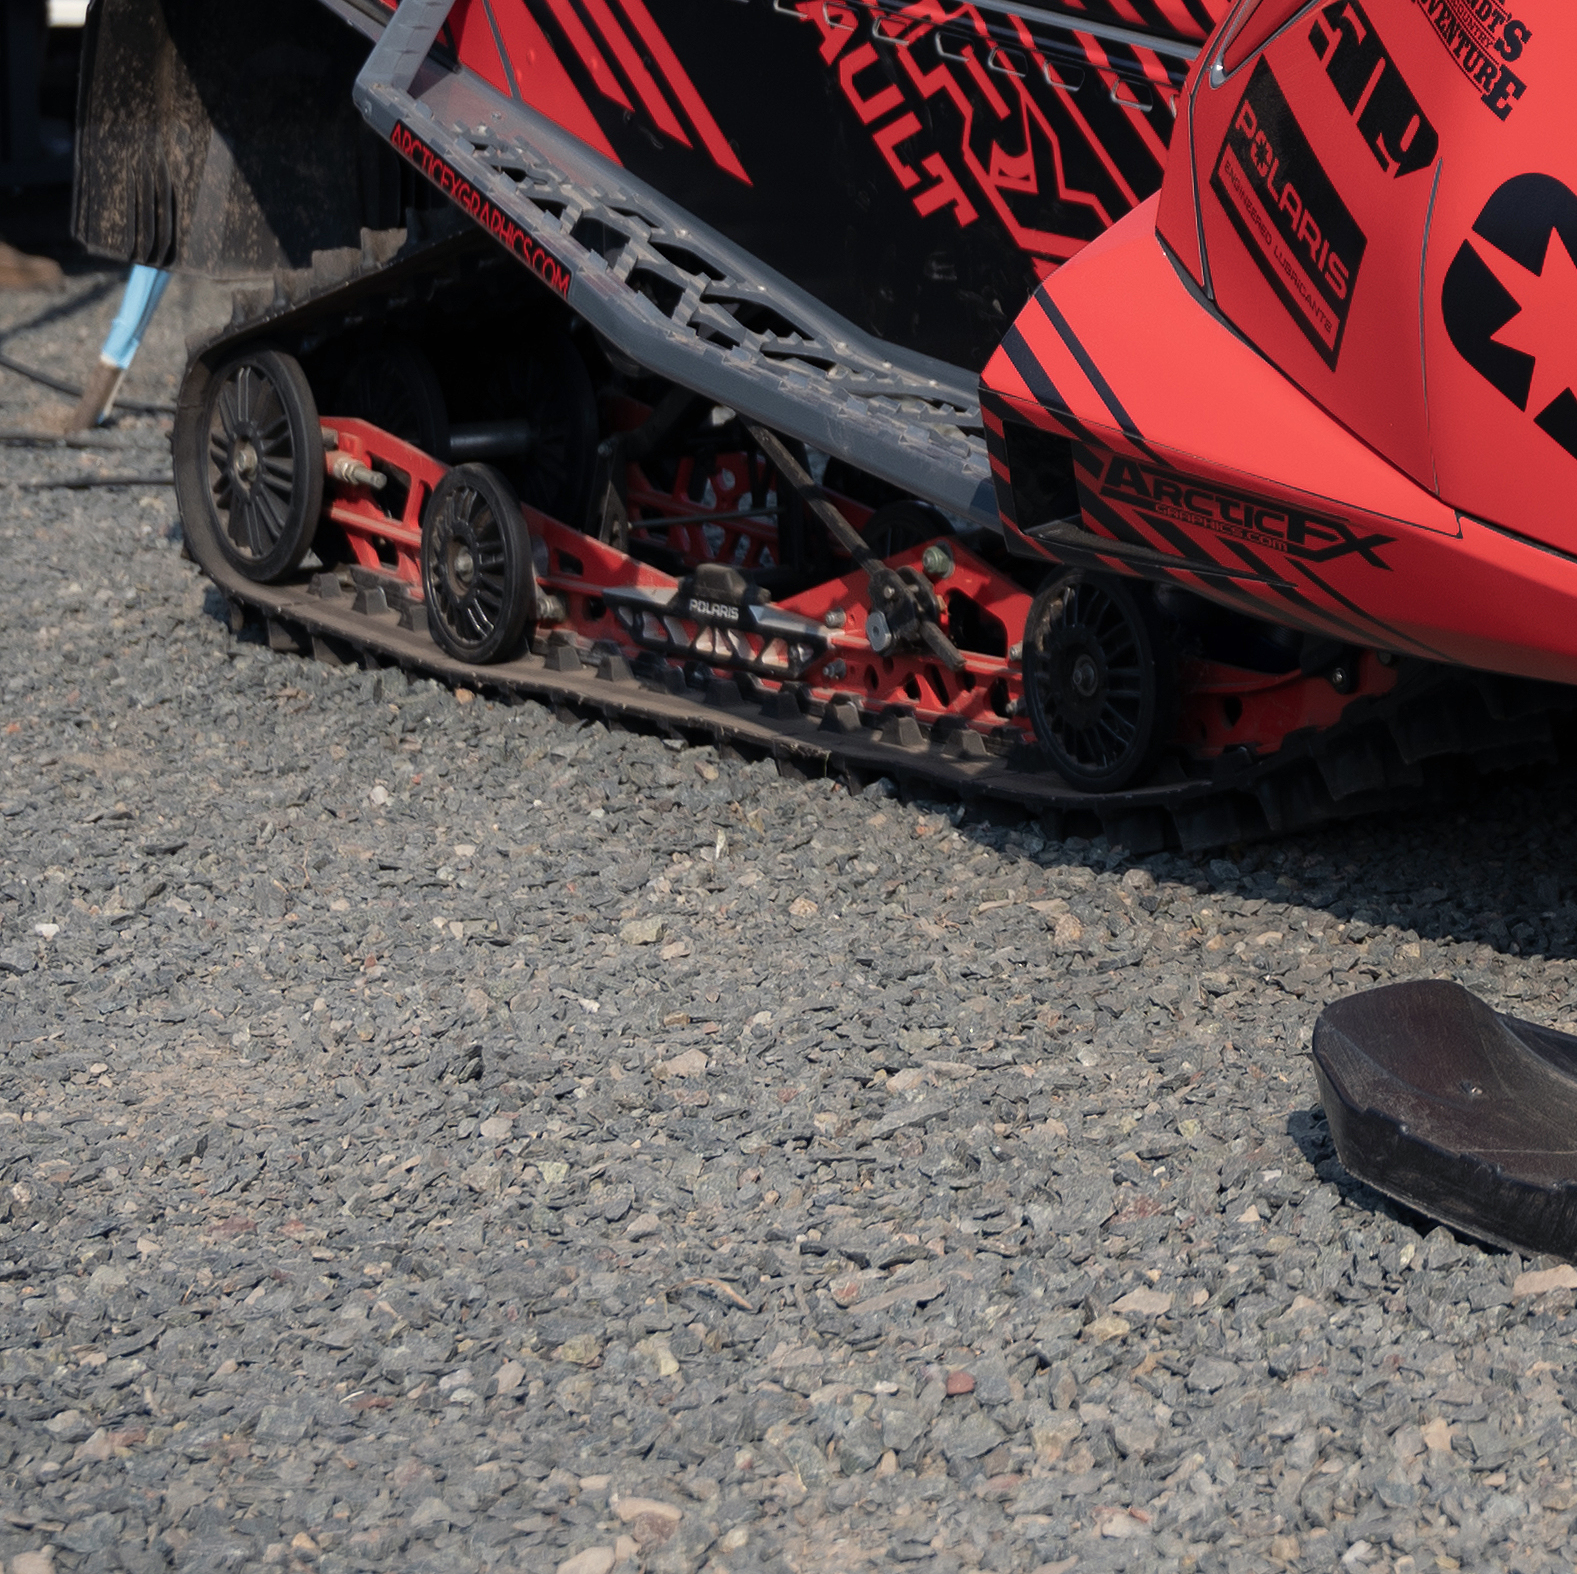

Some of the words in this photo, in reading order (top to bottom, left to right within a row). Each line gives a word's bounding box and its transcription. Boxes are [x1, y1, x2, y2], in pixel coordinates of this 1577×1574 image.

[391, 122, 572, 301] ARCTICFXGRAPHICS.COM
[1223, 158, 1273, 247] ENGINEERED
[1273, 243, 1333, 334] LUBRICANTS
[1235, 99, 1350, 301] POLARIS
[689, 598, 740, 621] POLARIS
